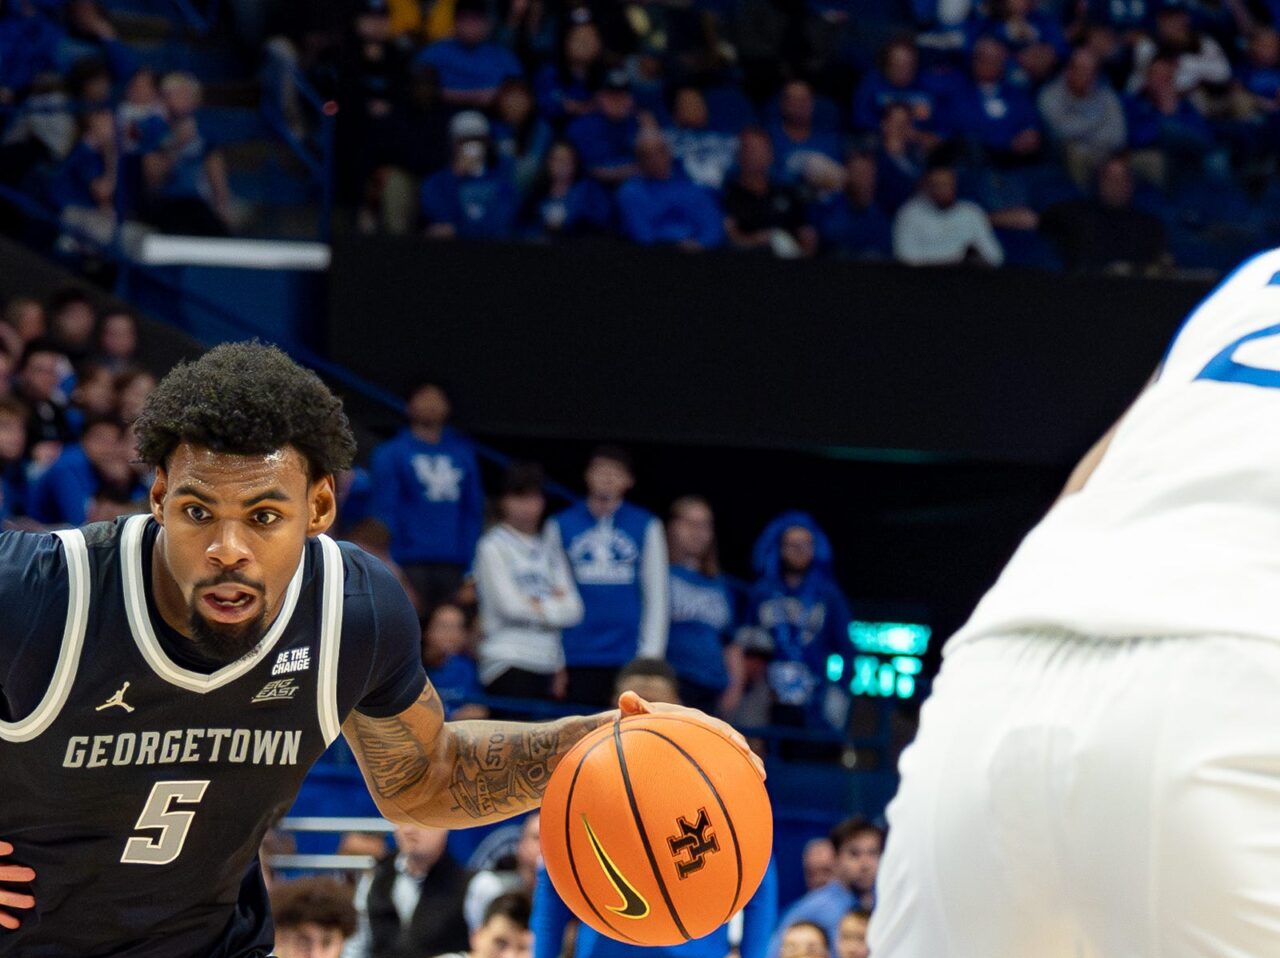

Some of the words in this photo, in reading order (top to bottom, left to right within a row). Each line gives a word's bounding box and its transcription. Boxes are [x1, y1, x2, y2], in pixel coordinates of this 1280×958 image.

[272, 658, 311, 675] CHANGE
[276, 651, 290, 664] BE
[291, 647, 310, 661] THE
[255, 686, 300, 698] EAST
[263, 678, 295, 690] BIG
[63, 728, 302, 768] GEORGETOWN
[486, 729, 505, 766] STO
[120, 780, 211, 866] 5
[666, 806, 721, 881] UK
